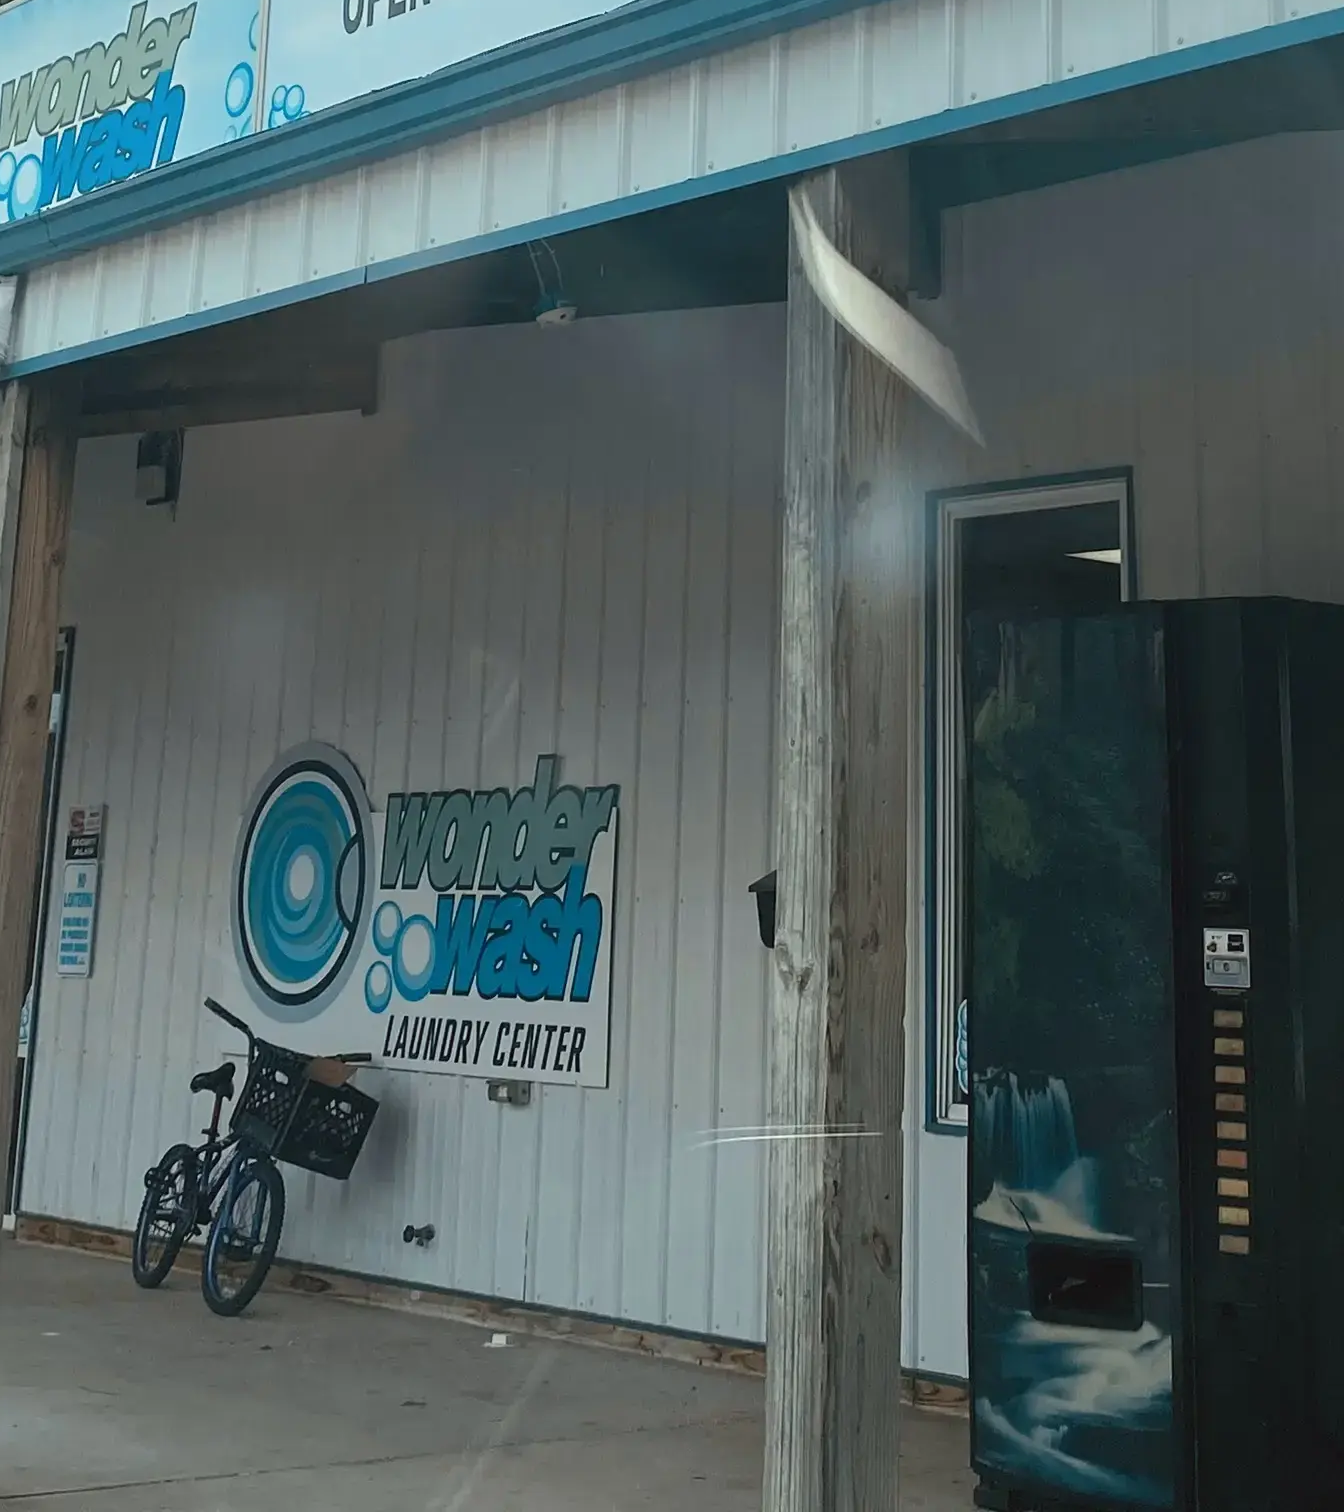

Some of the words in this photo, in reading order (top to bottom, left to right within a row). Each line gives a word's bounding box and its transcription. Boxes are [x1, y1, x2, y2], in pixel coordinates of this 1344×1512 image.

[39, 68, 186, 208] wash
[380, 753, 621, 892] wonder
[429, 863, 604, 1003] wash
[382, 1014, 490, 1065] LAUNDRY
[492, 1020, 587, 1073] CENTER
